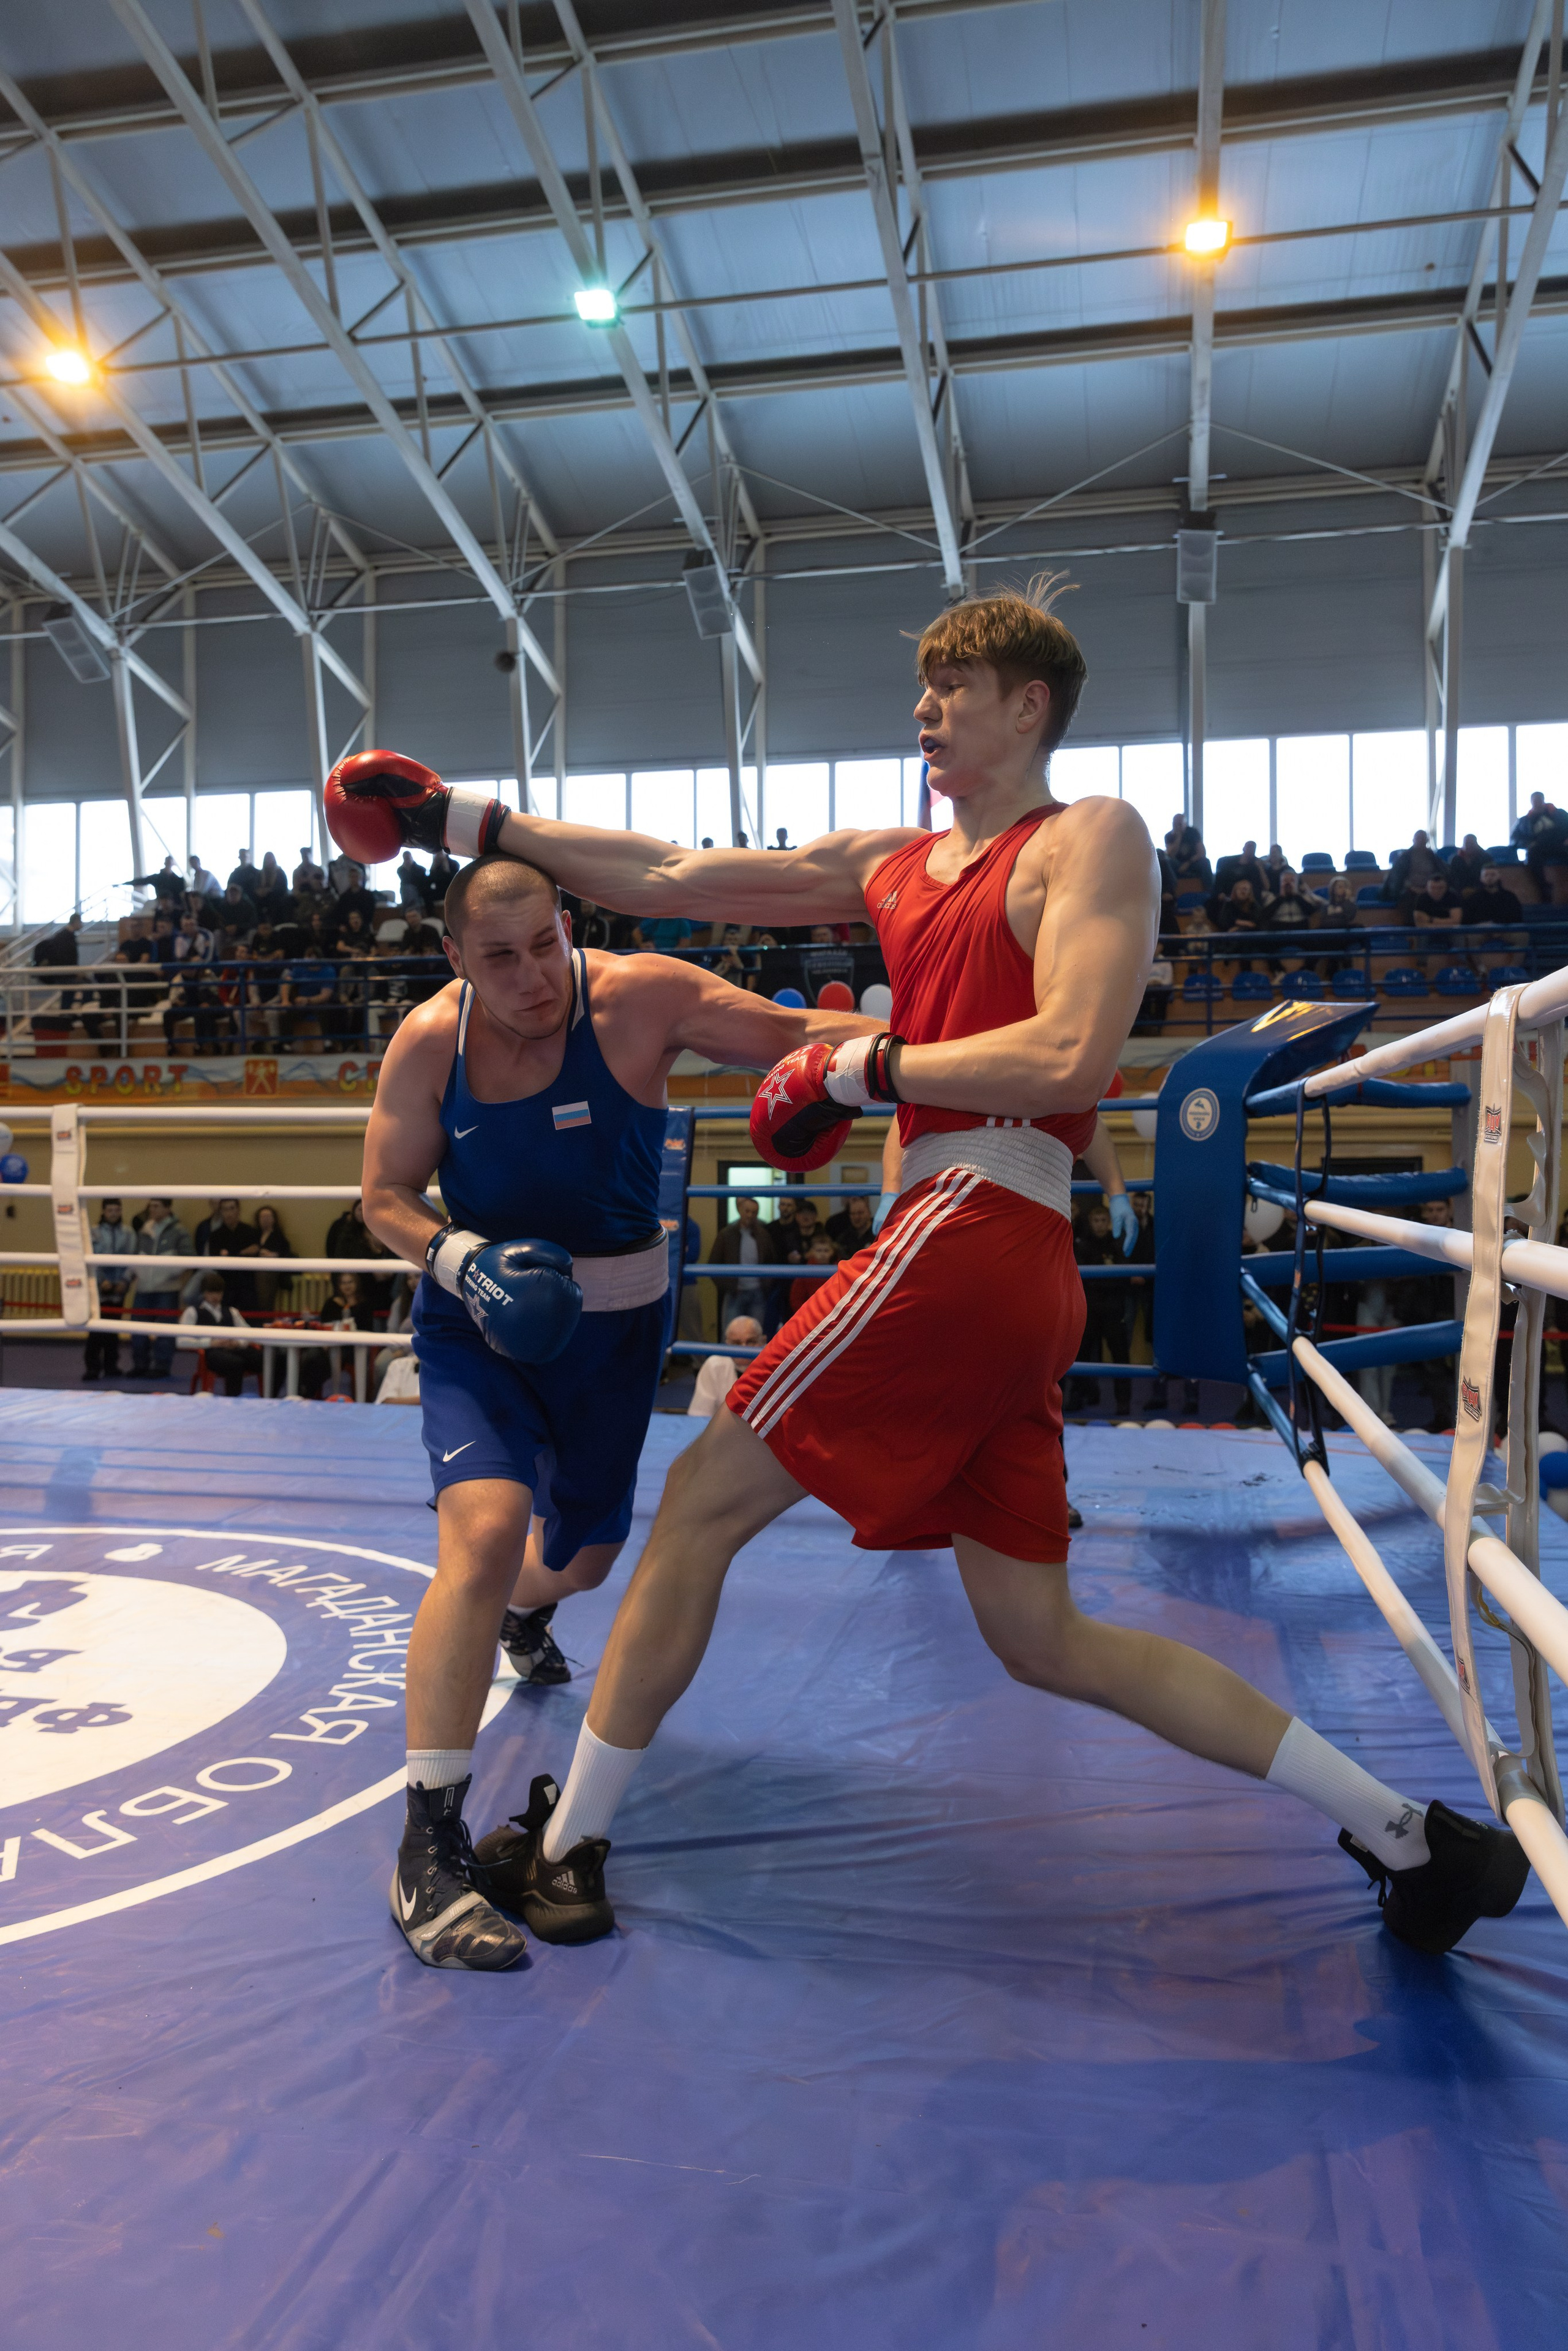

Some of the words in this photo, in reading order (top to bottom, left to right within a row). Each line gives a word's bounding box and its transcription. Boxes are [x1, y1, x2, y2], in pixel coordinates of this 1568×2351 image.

[787, 1054, 807, 1066] TEAM
[66, 1064, 189, 1095] SPORT
[477, 1288, 491, 1303] TEAM
[195, 1554, 414, 1745] МАГАДАНСКАЯ
[551, 1879, 578, 1894] adidas
[449, 1900, 466, 1917] NIKE
